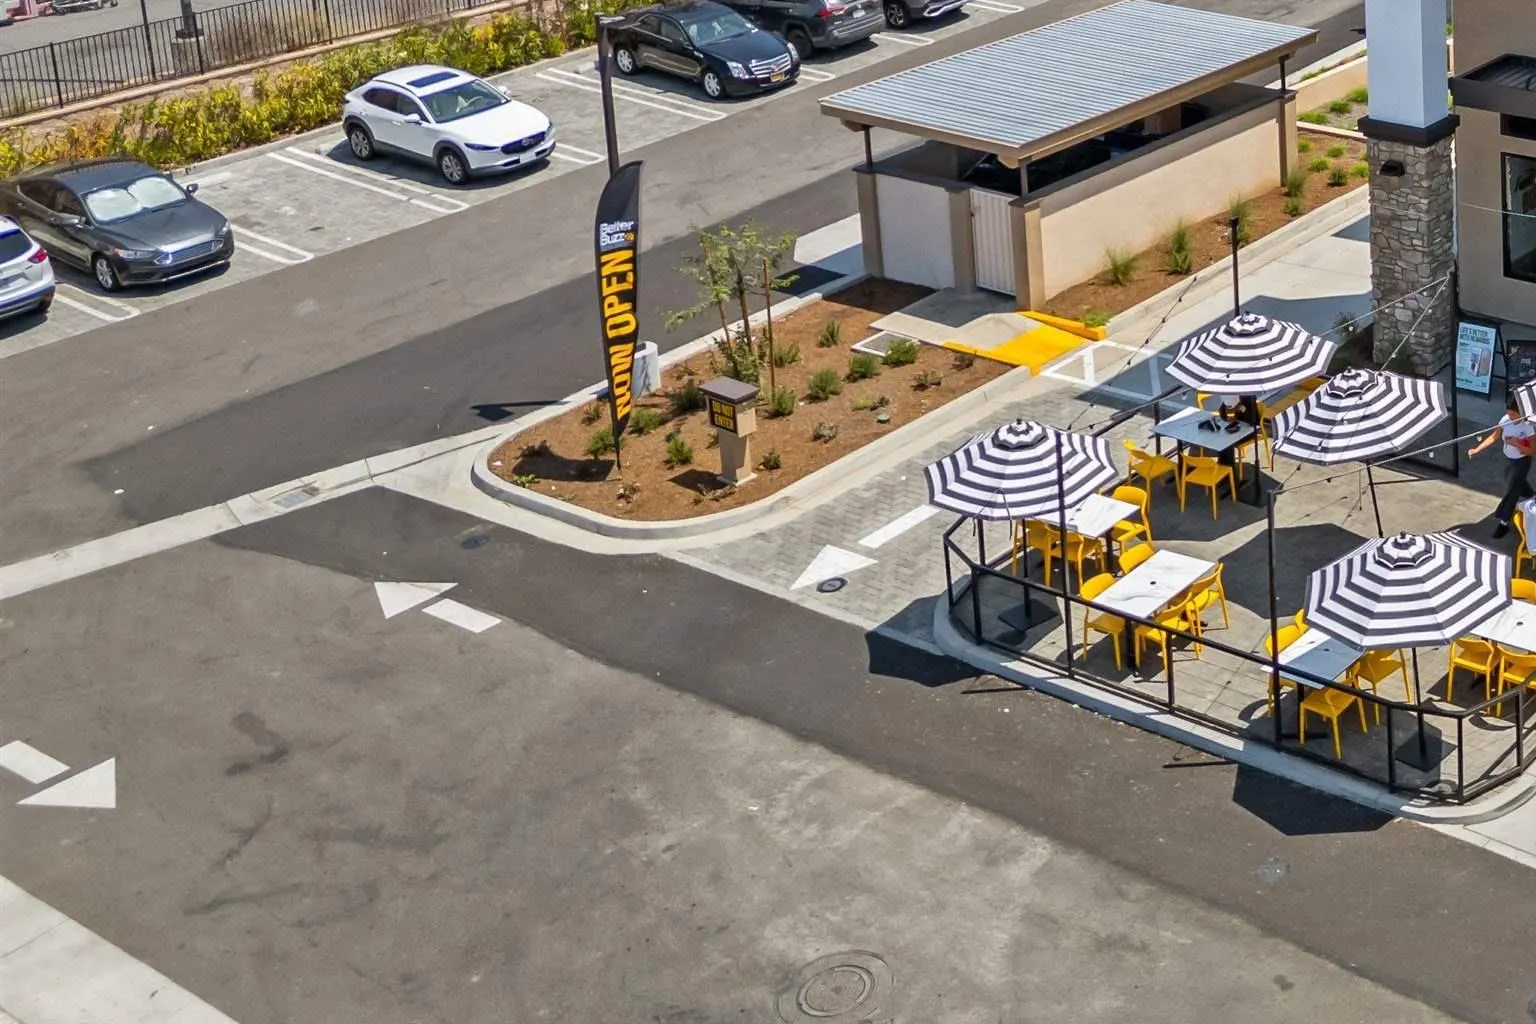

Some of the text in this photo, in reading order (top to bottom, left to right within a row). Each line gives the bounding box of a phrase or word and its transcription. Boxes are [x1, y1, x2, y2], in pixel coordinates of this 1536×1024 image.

[600, 220, 635, 234] Better
[600, 232, 625, 246] Buzz
[600, 249, 637, 422] NOW OPEN
